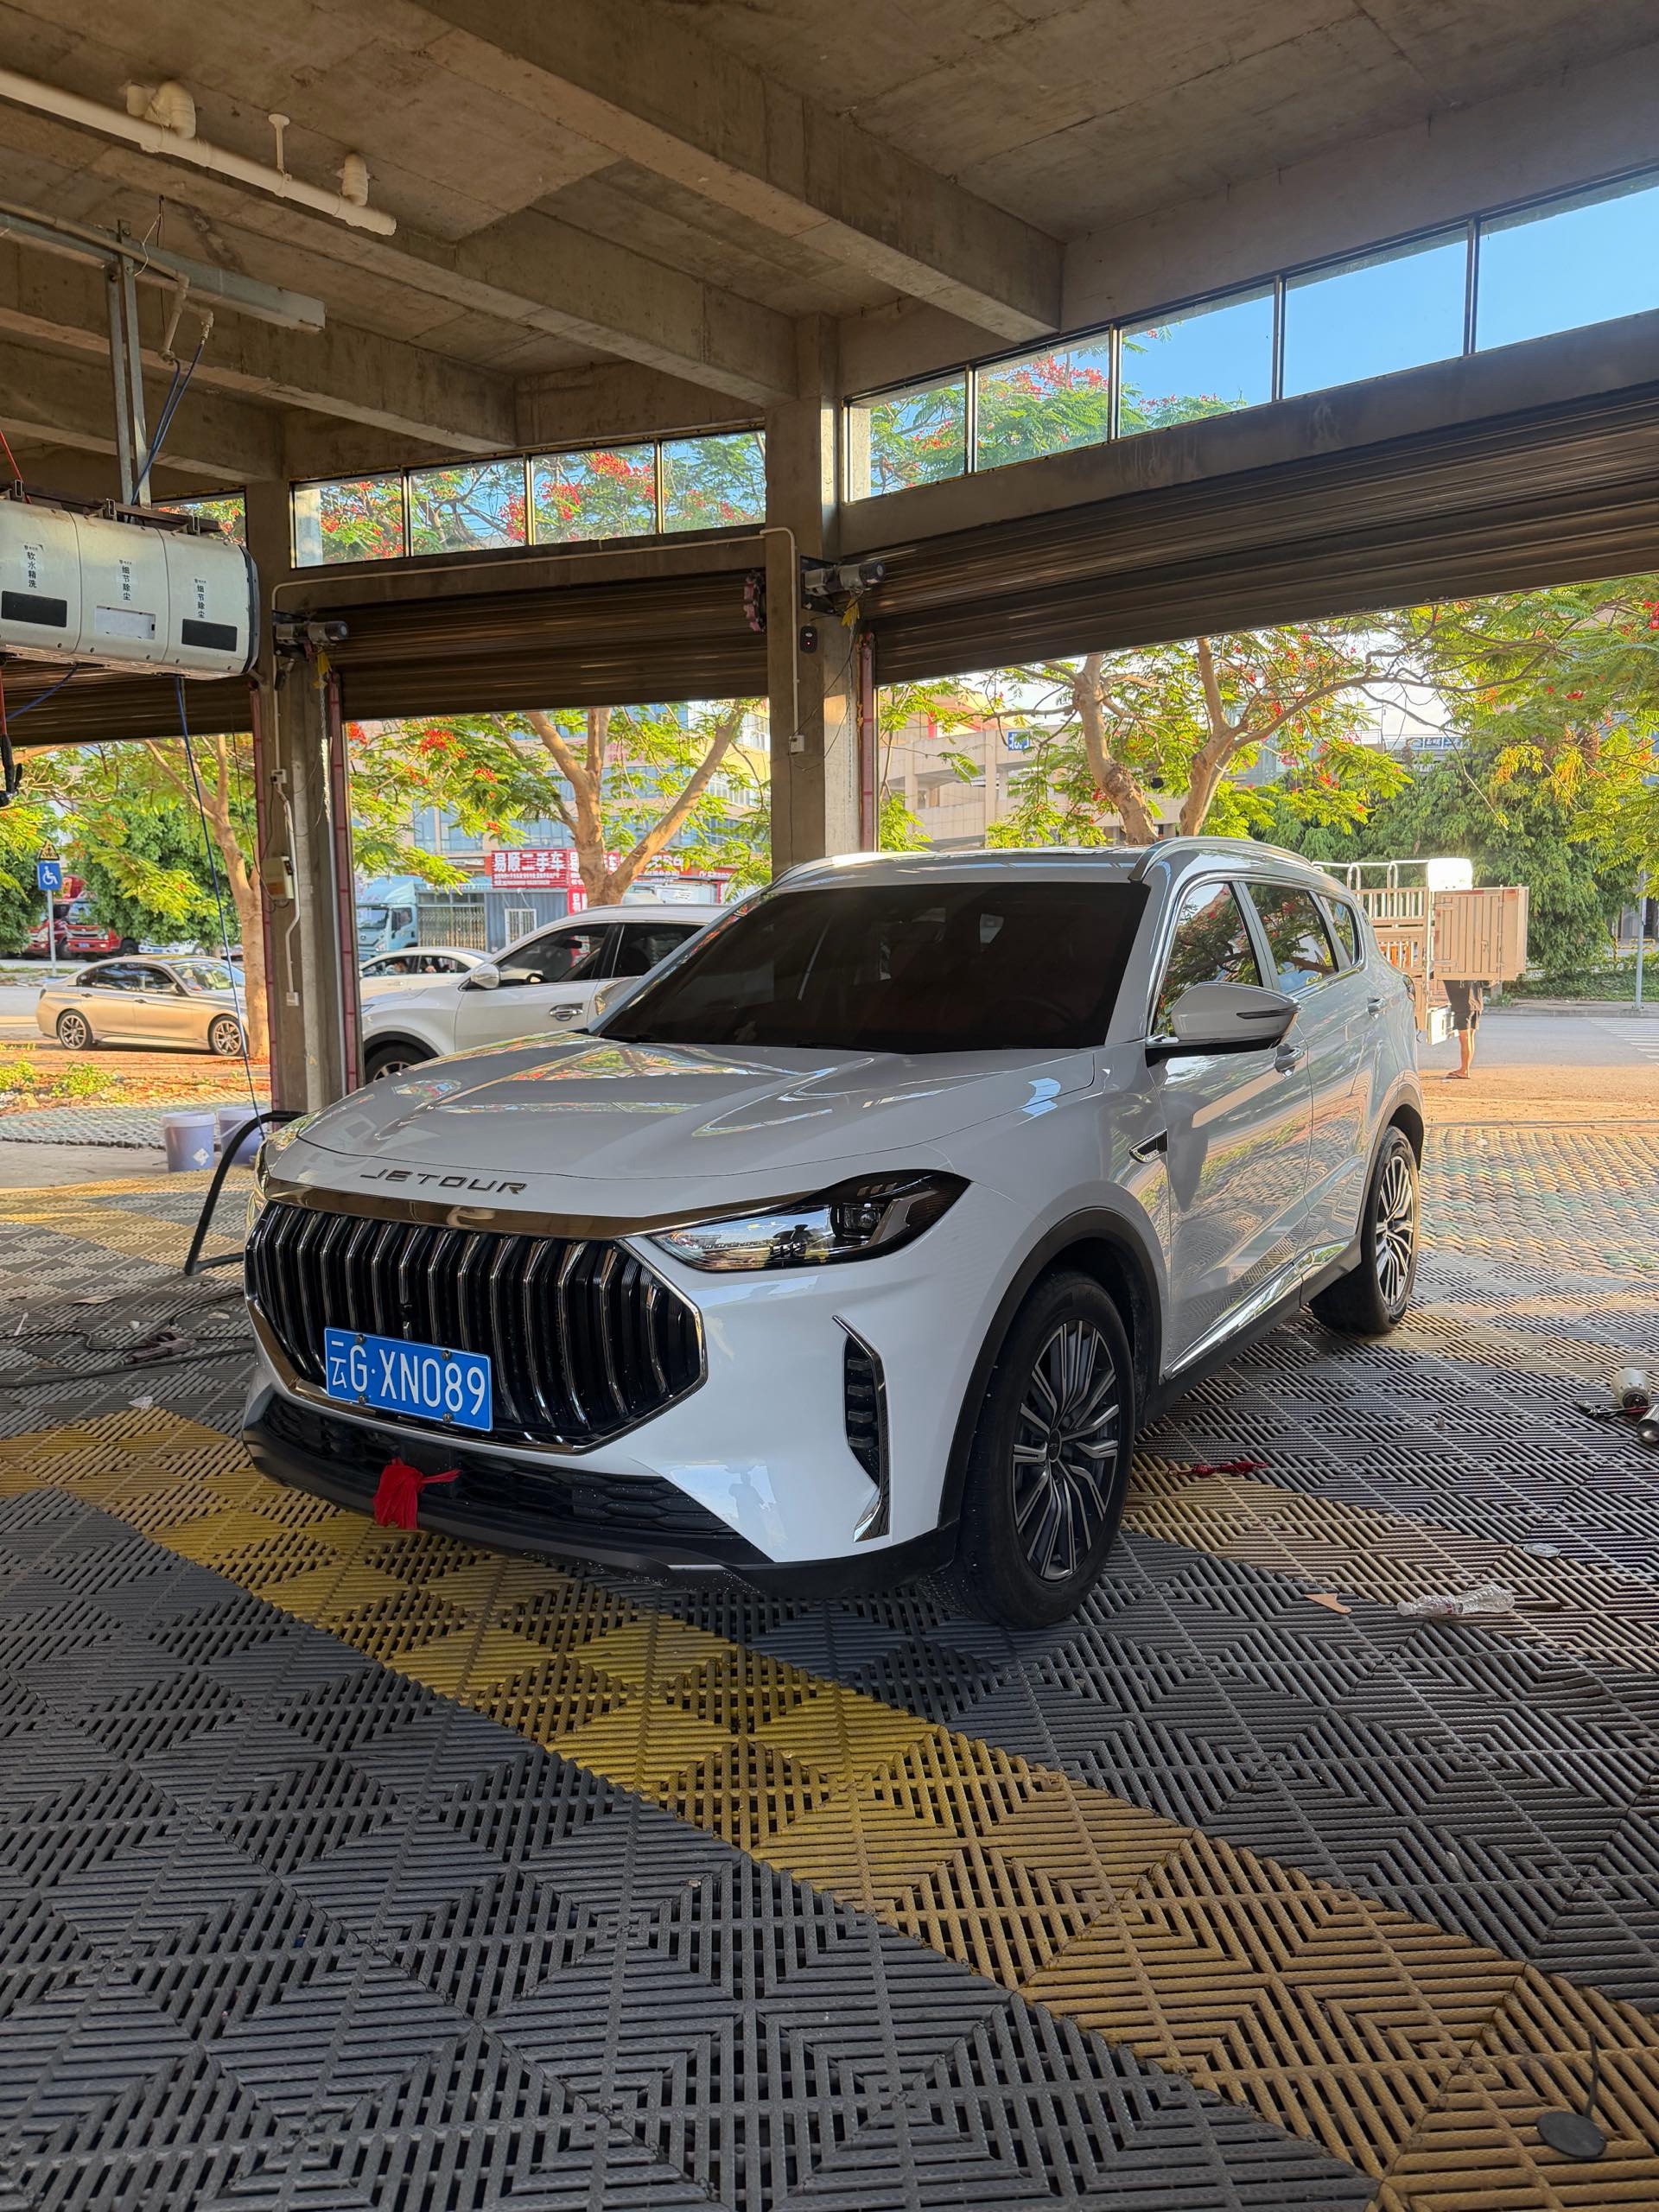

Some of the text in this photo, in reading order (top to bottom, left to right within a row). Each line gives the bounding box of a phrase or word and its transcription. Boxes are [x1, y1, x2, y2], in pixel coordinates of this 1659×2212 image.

[122, 565, 131, 601] 细节除尘
[197, 584, 206, 619] 细节除尘
[493, 851, 565, 873] 易顺二手车
[359, 1168, 528, 1195] JETOUR
